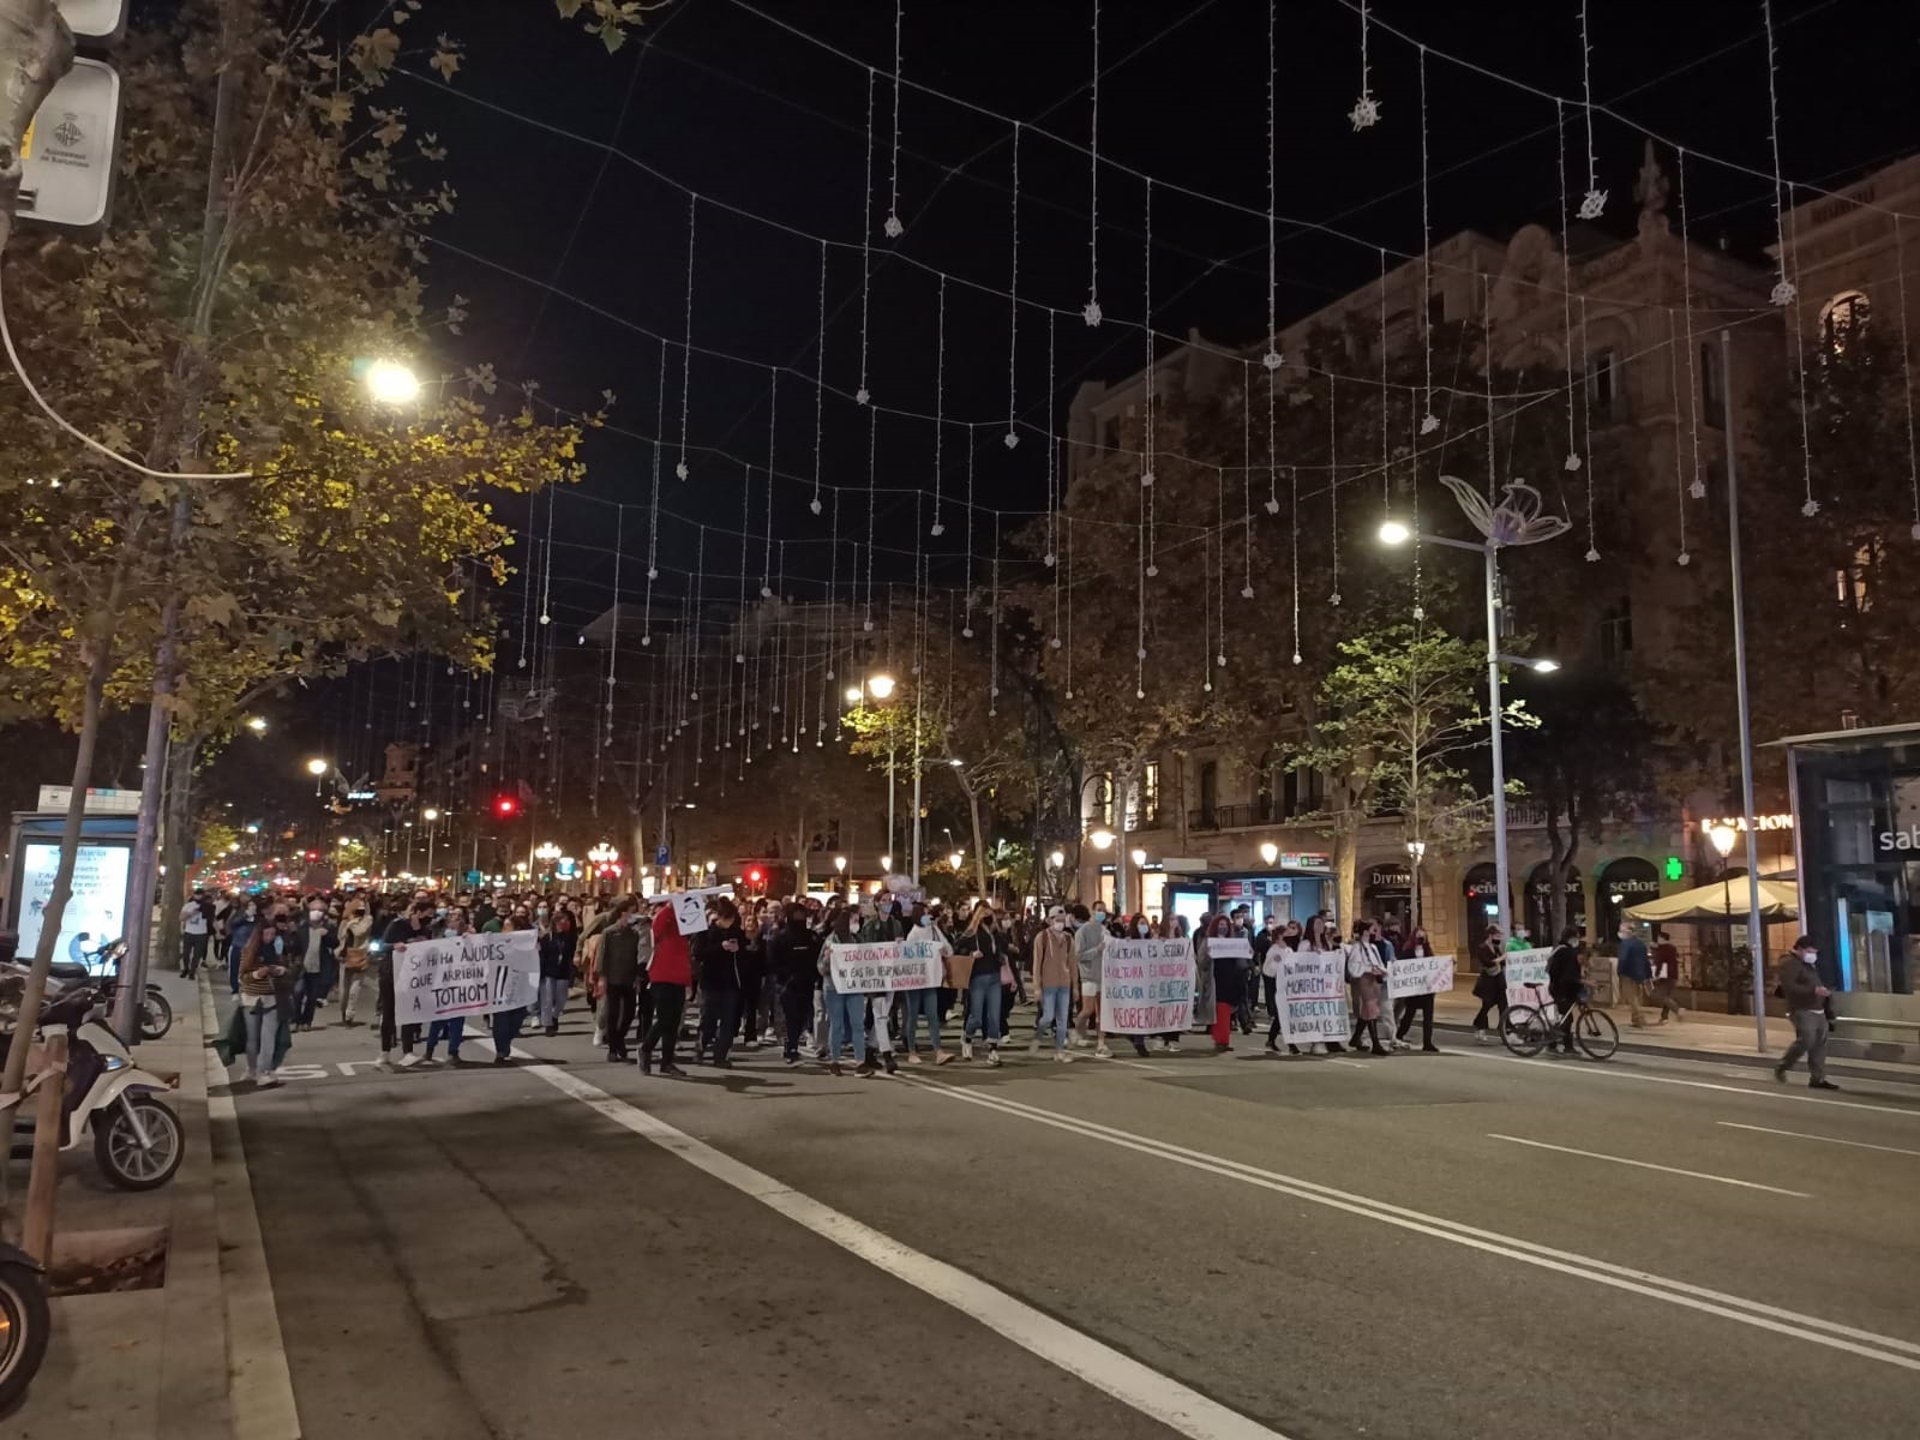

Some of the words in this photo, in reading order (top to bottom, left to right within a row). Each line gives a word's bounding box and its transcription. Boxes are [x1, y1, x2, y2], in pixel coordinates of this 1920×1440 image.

[410, 972, 432, 989] QUE
[442, 966, 484, 982] ARRIBIN
[413, 996, 421, 1011] A
[432, 983, 488, 1008] TOTHOM
